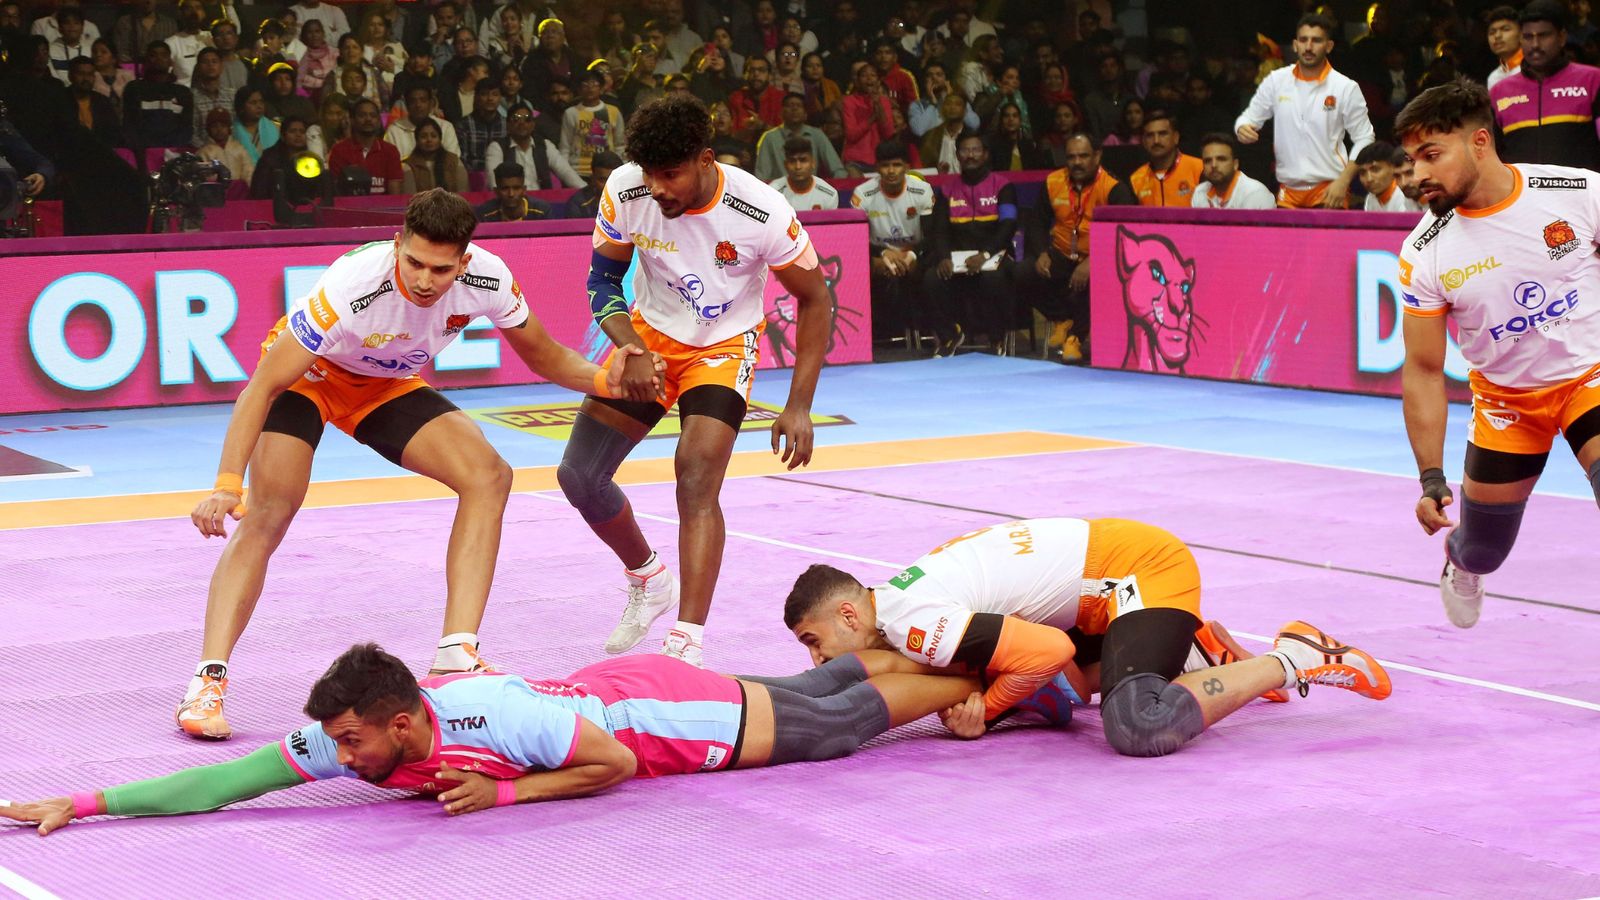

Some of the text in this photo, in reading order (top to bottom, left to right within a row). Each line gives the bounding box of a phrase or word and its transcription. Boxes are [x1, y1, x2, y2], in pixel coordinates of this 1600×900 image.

[1550, 86, 1588, 98] TYKA
[1541, 179, 1586, 188] VISION11
[733, 199, 768, 222] VISION11
[1489, 289, 1579, 341] FORCE
[28, 269, 249, 391] OR
[447, 715, 488, 732] TYKA
